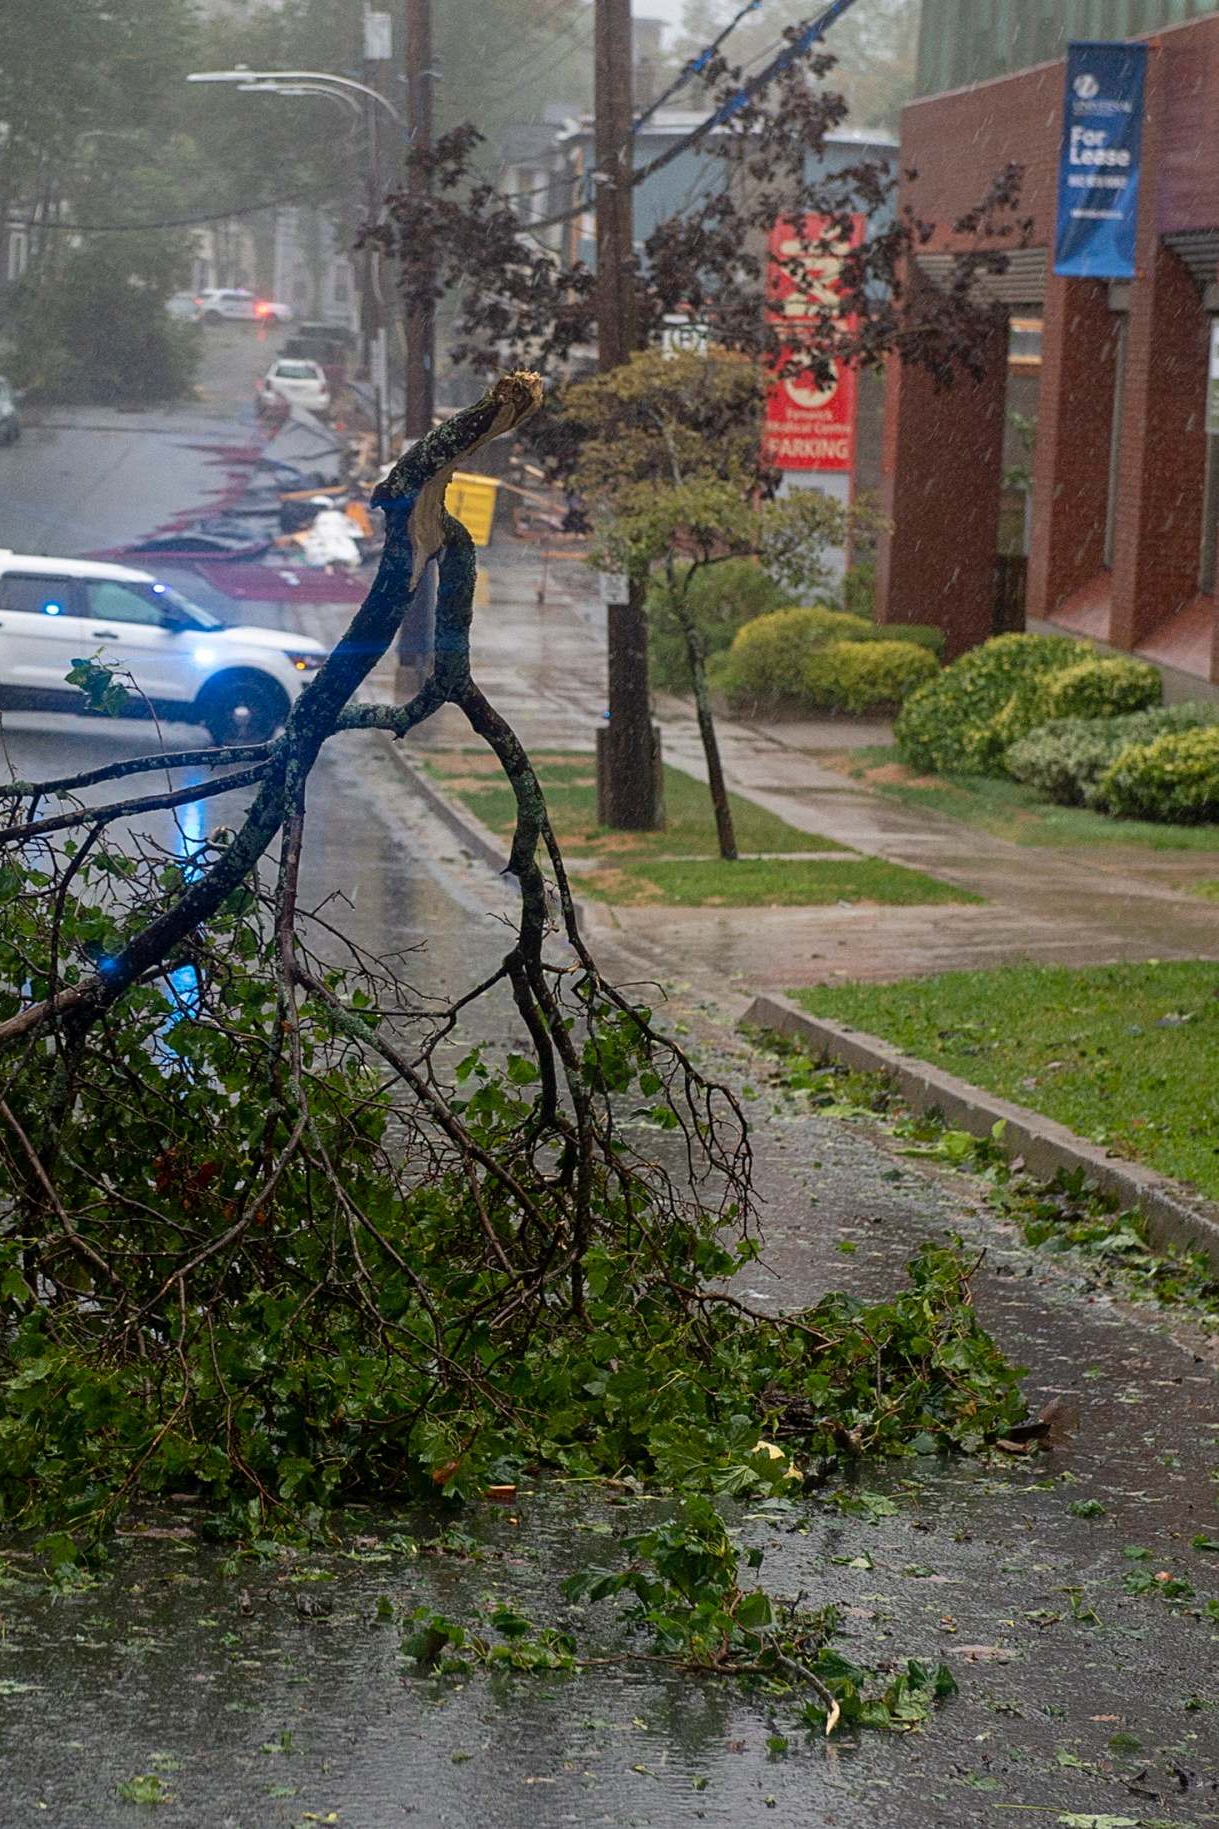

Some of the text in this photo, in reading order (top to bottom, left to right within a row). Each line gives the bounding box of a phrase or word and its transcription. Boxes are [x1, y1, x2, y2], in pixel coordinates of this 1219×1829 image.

[1070, 126, 1107, 147] For
[1069, 148, 1131, 167] Lease
[765, 438, 849, 459] PARKING
